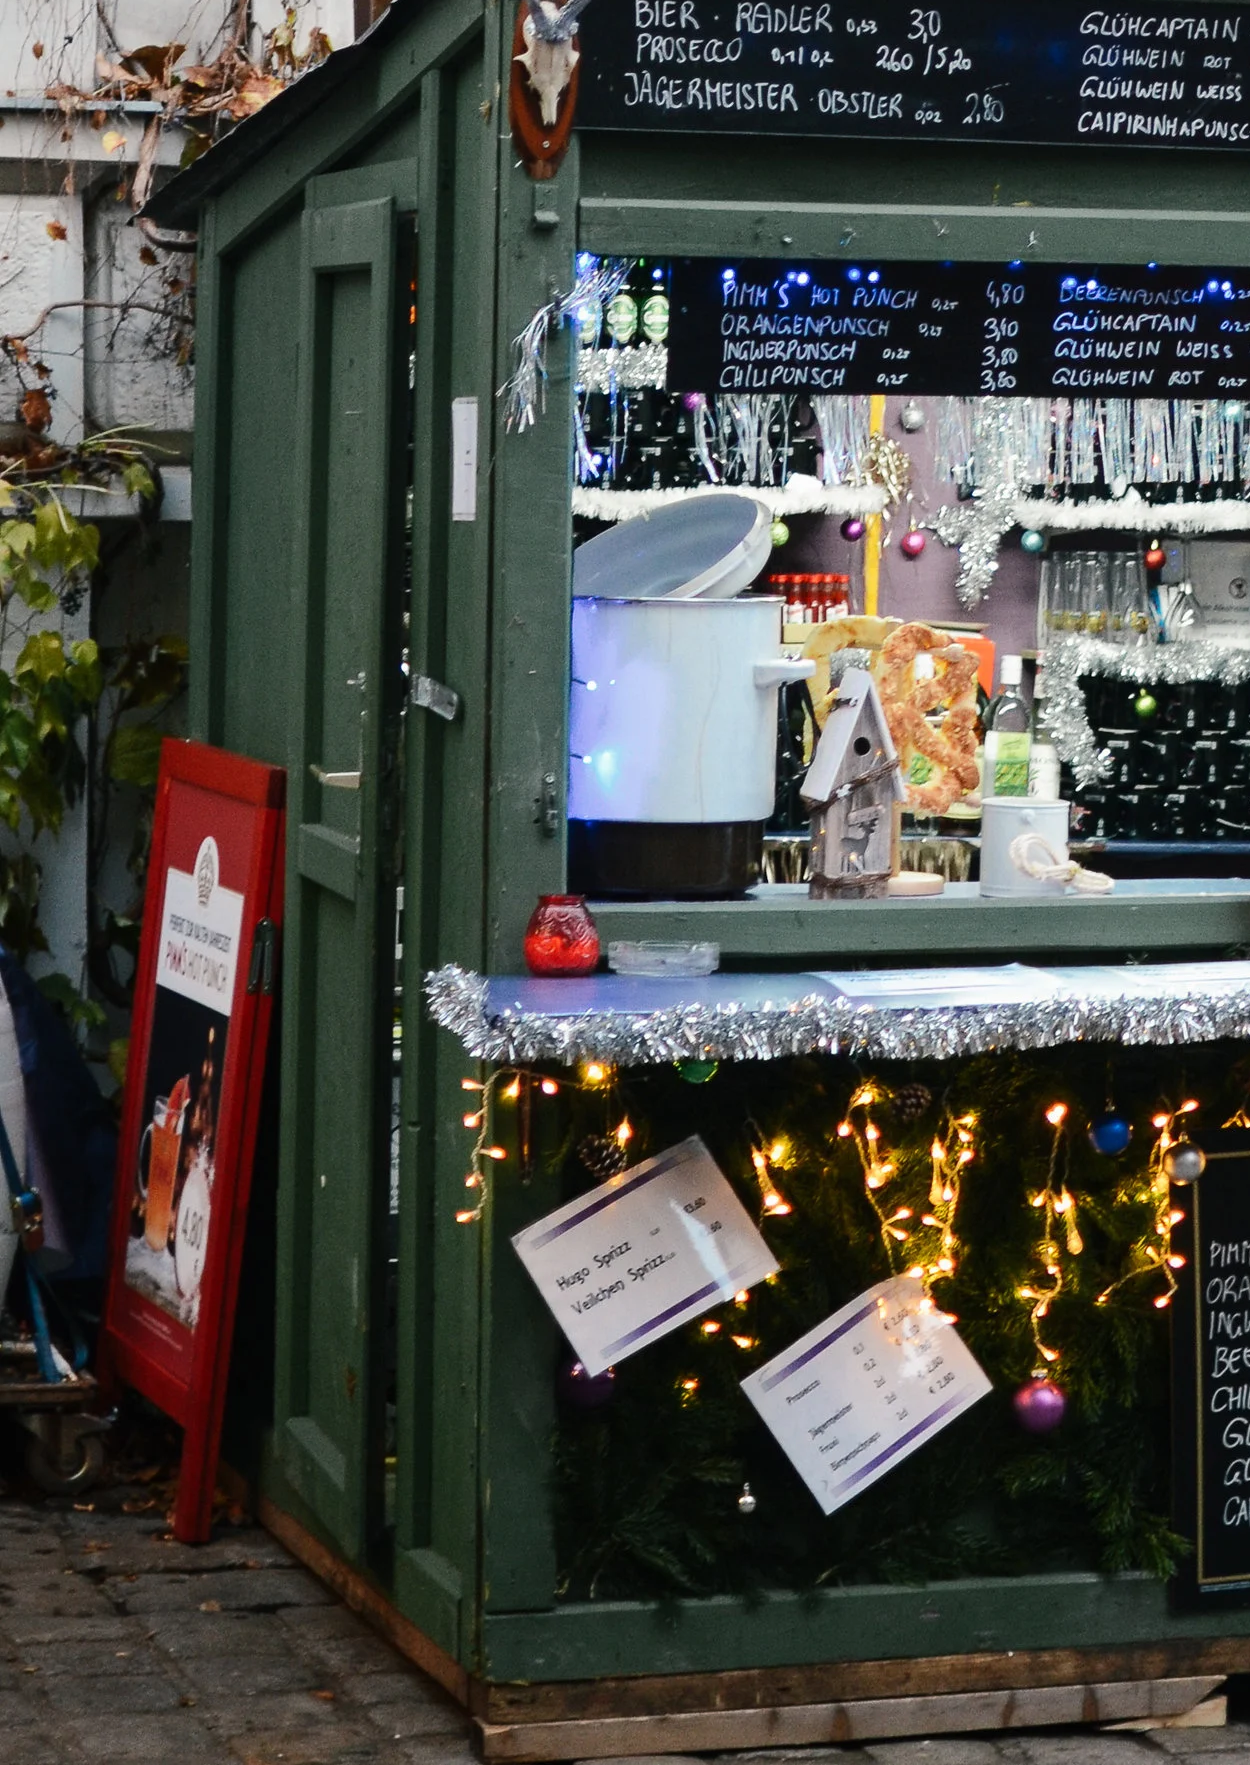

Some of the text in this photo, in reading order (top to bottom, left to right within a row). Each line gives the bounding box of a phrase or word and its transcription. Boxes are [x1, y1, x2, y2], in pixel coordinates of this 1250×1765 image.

[636, 0, 699, 30] BIER
[908, 9, 940, 43] 3,0
[1080, 11, 1240, 42] GLÜHCAPTAIN
[636, 37, 742, 63] PROSECCO
[1082, 44, 1184, 69] GLÜHWEIN
[1204, 56, 1231, 69] ROT
[1080, 76, 1184, 99] GLÜHWEIN
[1197, 86, 1242, 101] WEISS
[818, 89, 902, 119] OBSTLER
[963, 94, 1004, 124] 2,80
[556, 1241, 632, 1291] Hugo Sprizz
[627, 1254, 665, 1281] Sprizz
